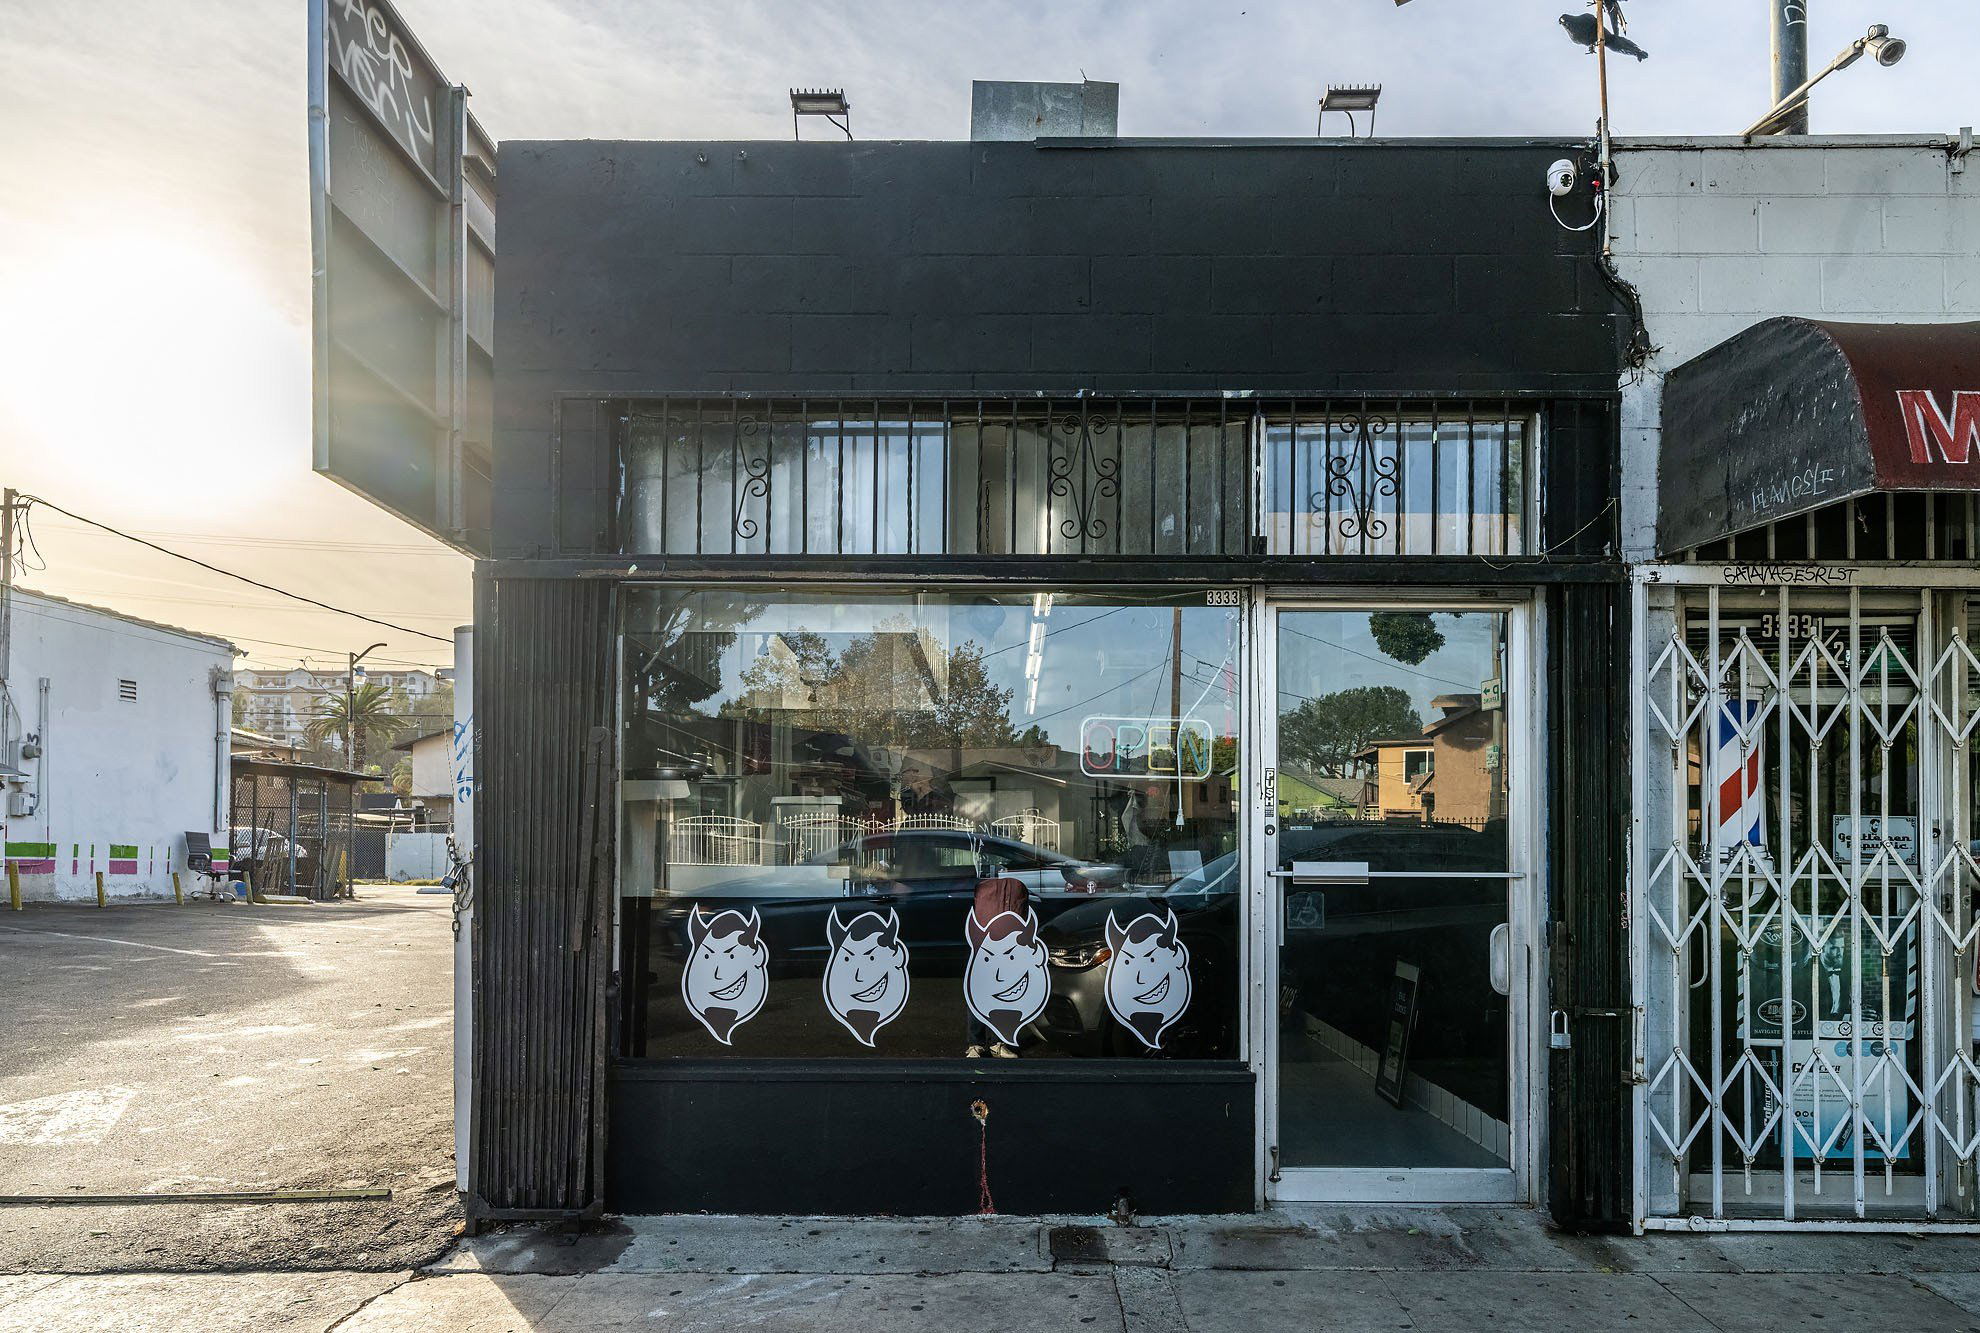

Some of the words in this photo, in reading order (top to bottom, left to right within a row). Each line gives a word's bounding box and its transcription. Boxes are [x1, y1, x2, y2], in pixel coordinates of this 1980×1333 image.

[1208, 591, 1238, 604] 3333
[1085, 724, 1208, 772] OPEN
[1265, 771, 1274, 806] PUSH
[1838, 832, 1912, 843] Getleen
